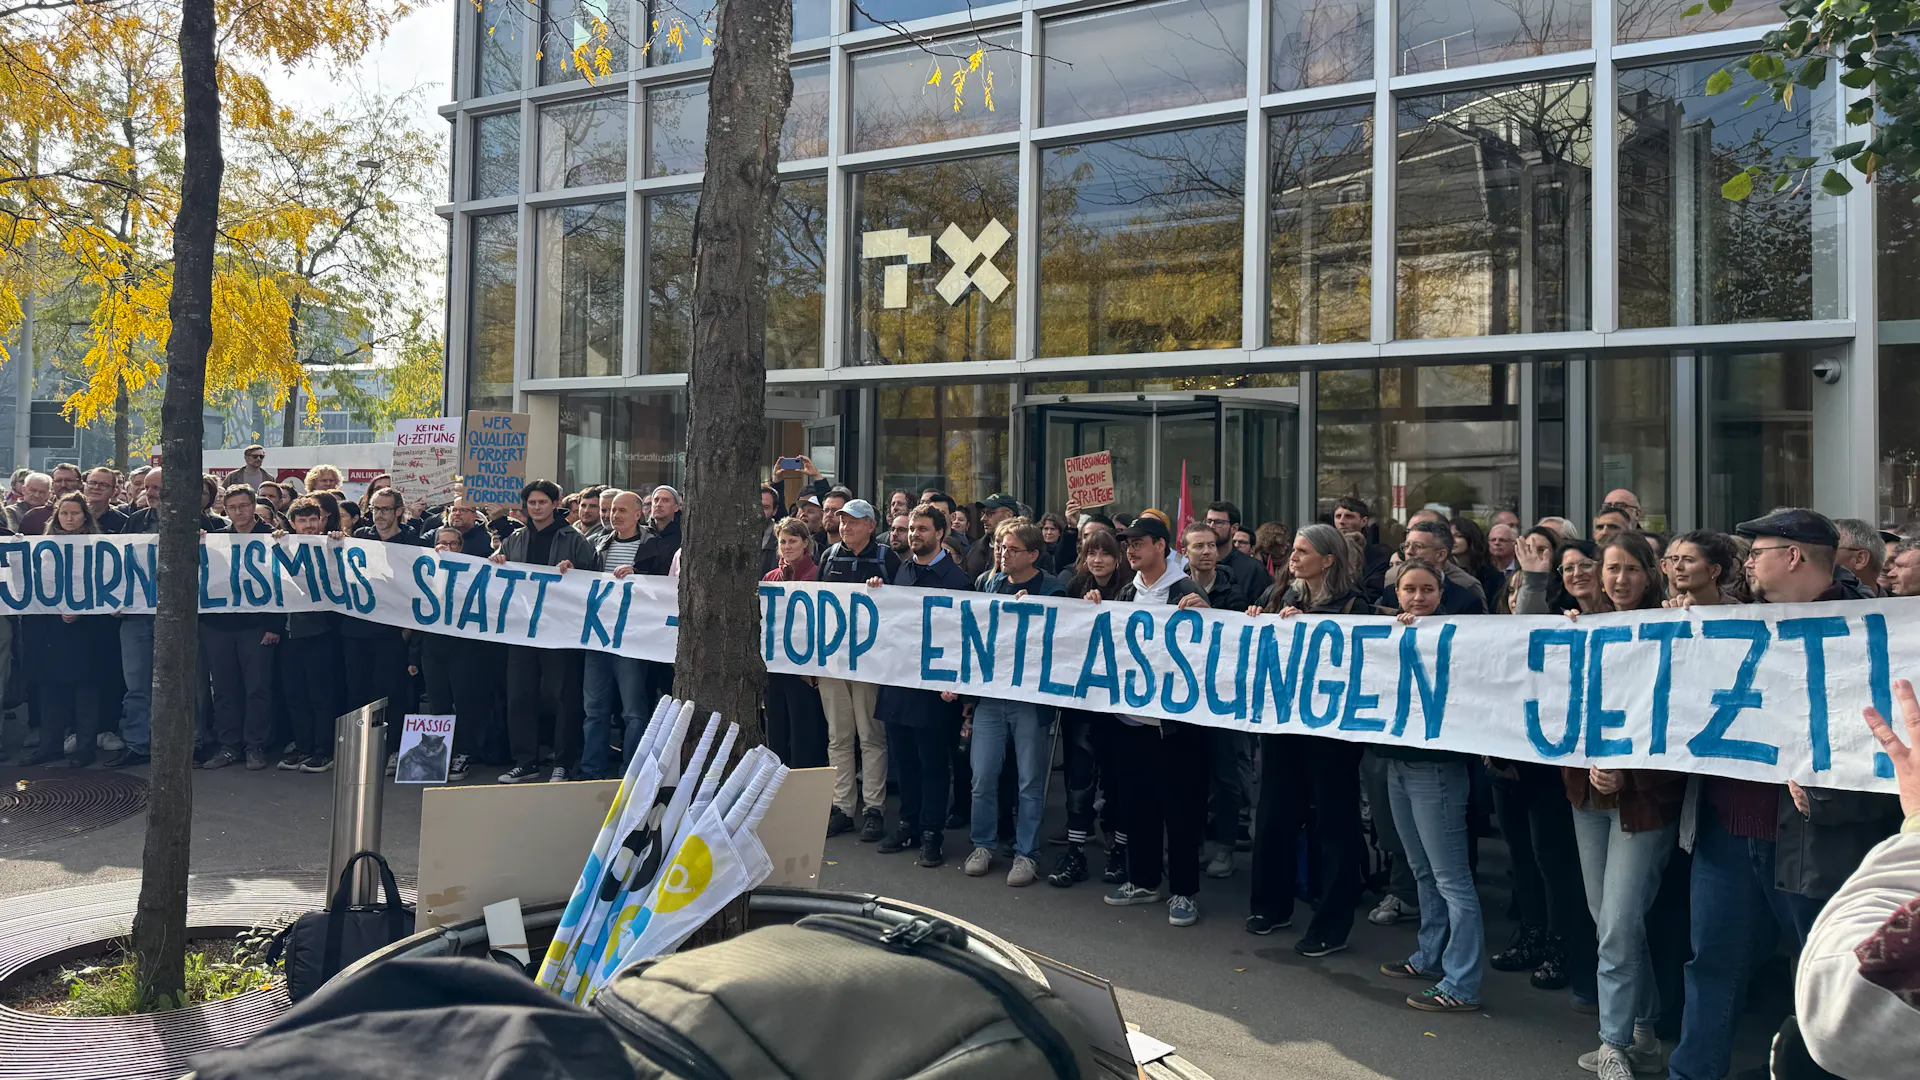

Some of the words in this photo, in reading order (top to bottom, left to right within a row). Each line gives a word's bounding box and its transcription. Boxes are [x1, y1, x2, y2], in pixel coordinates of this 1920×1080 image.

[416, 424, 445, 432] KEINE
[482, 416, 512, 430] WER
[397, 433, 456, 446] KI-ZEITUNG
[469, 430, 527, 447] QUALITÄT
[478, 462, 508, 474] MUSS
[1066, 453, 1111, 473] ENTLASSUNGEN
[463, 474, 524, 490] MENSCHEN
[1069, 476, 1084, 489] SIND
[1085, 471, 1106, 486] KEINE
[0, 540, 377, 614] JOURNLISMUS
[412, 555, 562, 638] STATT
[580, 579, 634, 649] KI
[759, 586, 879, 671] TOPP
[921, 595, 1457, 741] ENTLASSUNGEN
[405, 718, 451, 732] HÄSSIG
